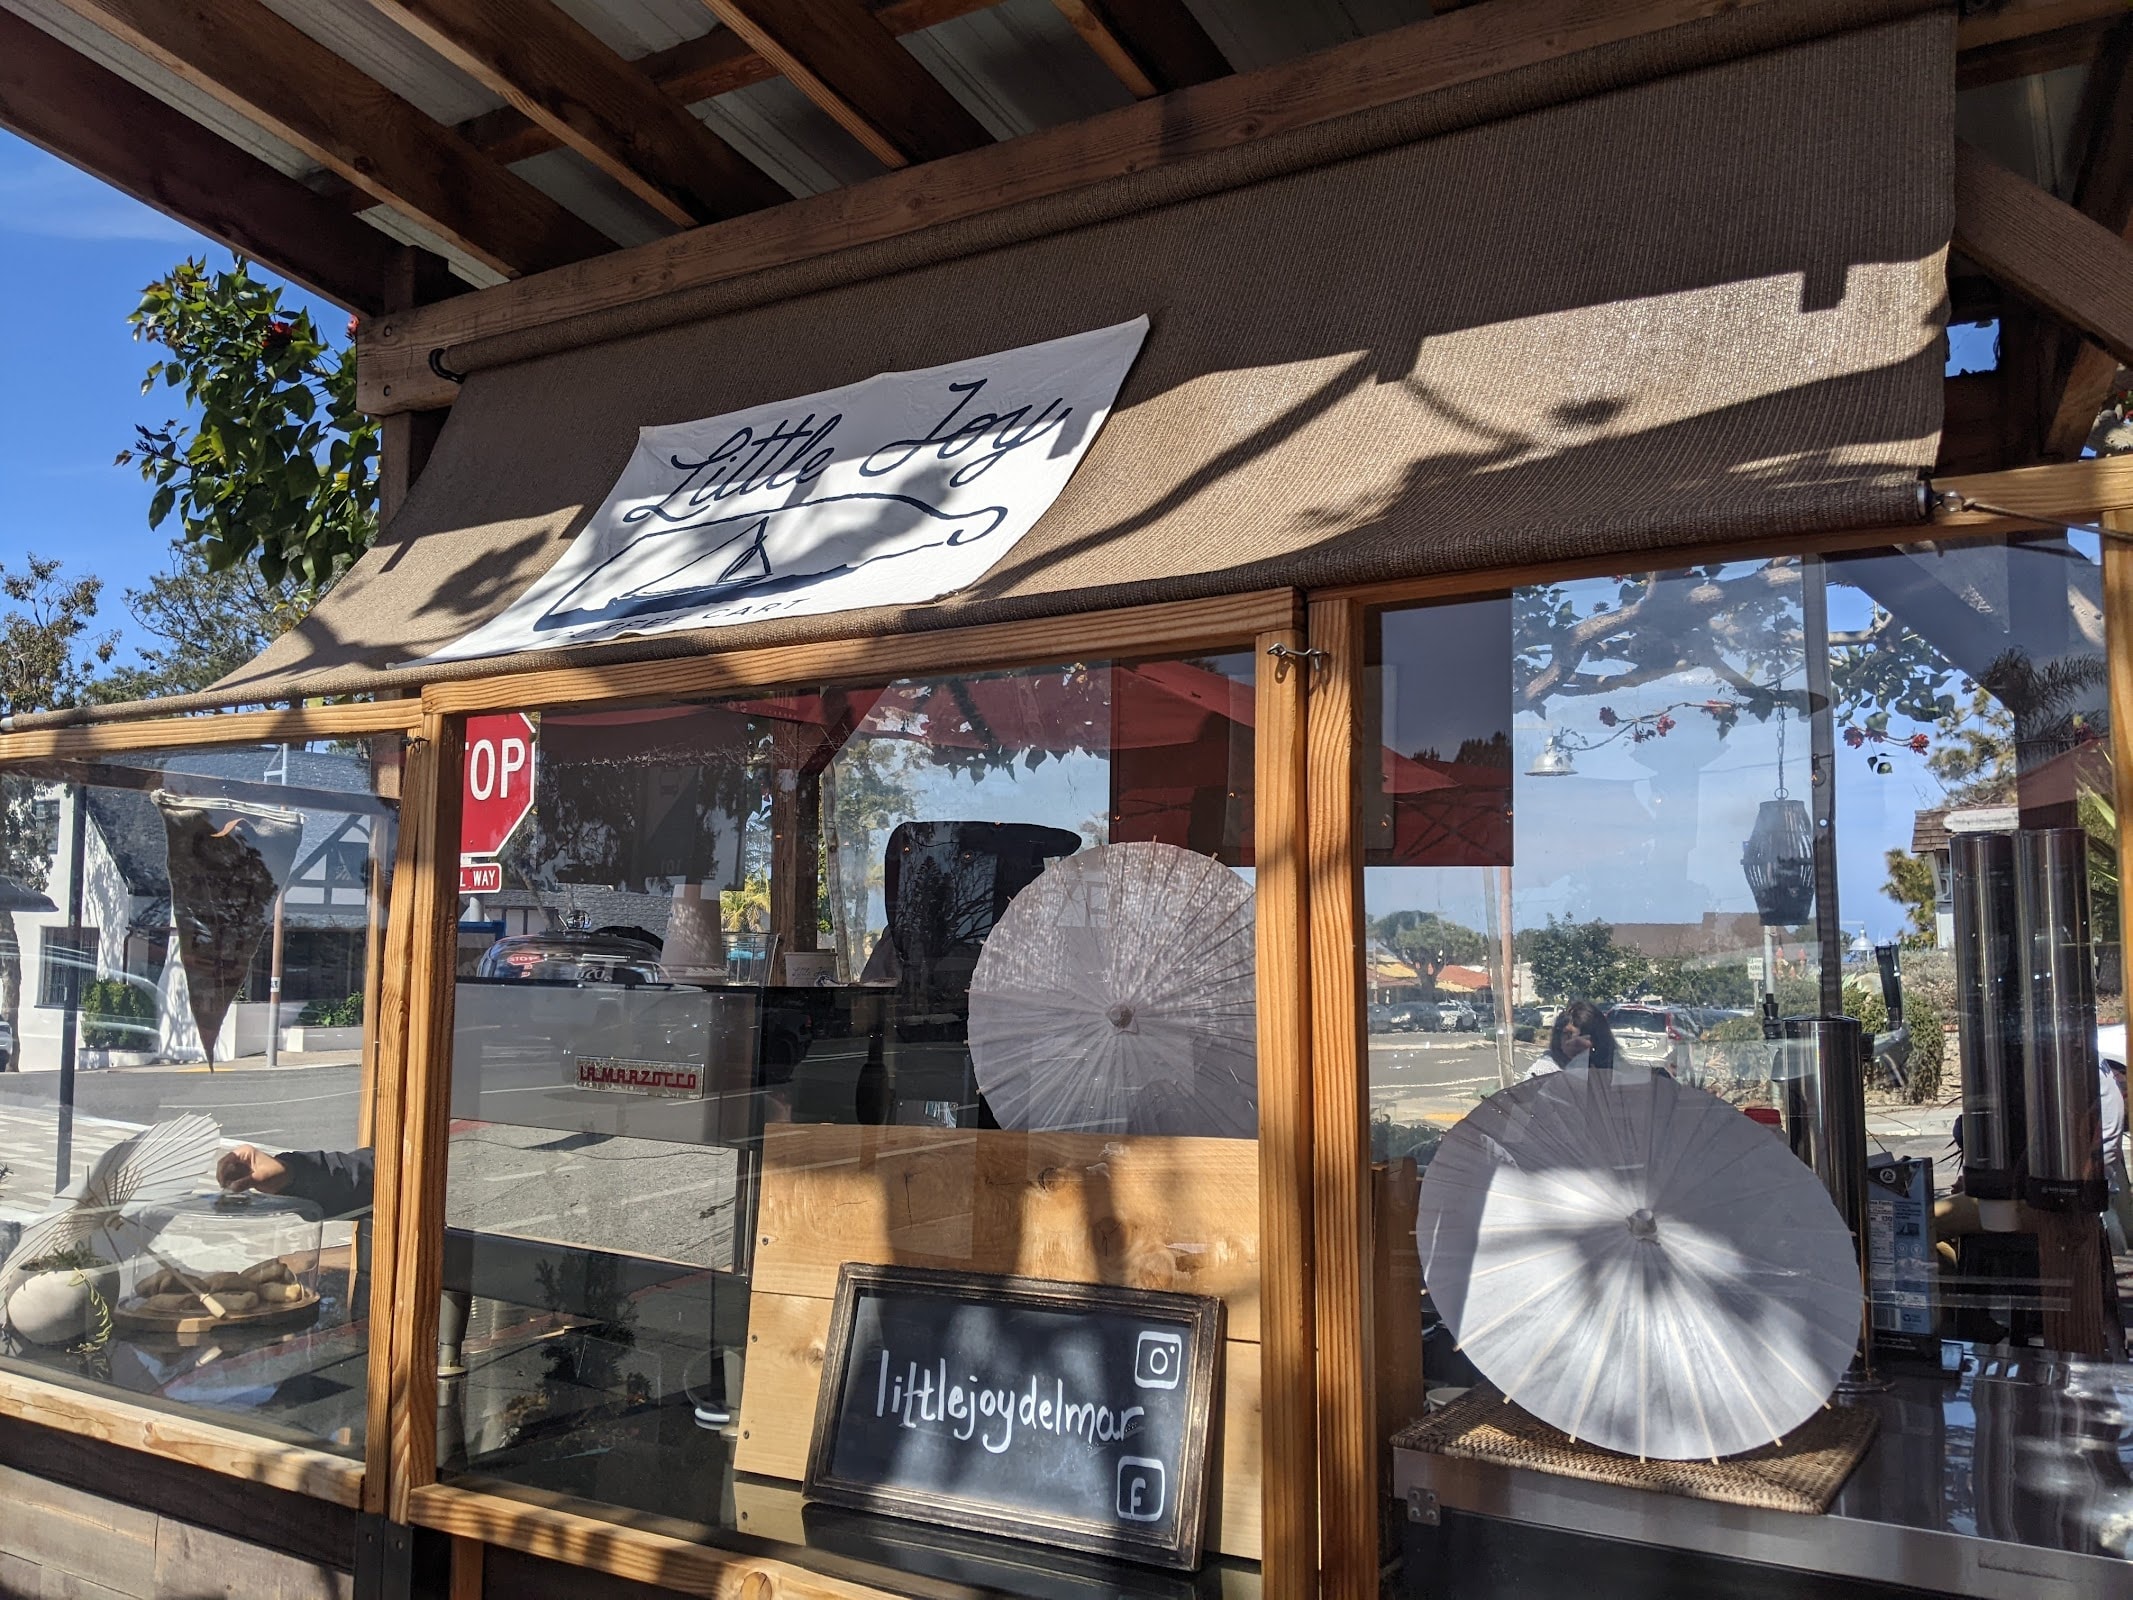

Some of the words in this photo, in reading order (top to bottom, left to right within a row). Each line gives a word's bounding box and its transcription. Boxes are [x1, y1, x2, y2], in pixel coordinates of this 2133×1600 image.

[622, 413, 843, 523] Little
[859, 378, 1073, 487] Joy
[702, 598, 811, 619] CART
[465, 738, 525, 801] OP
[473, 870, 496, 887] WAY
[876, 1350, 1144, 1454] littlejoydelmar
